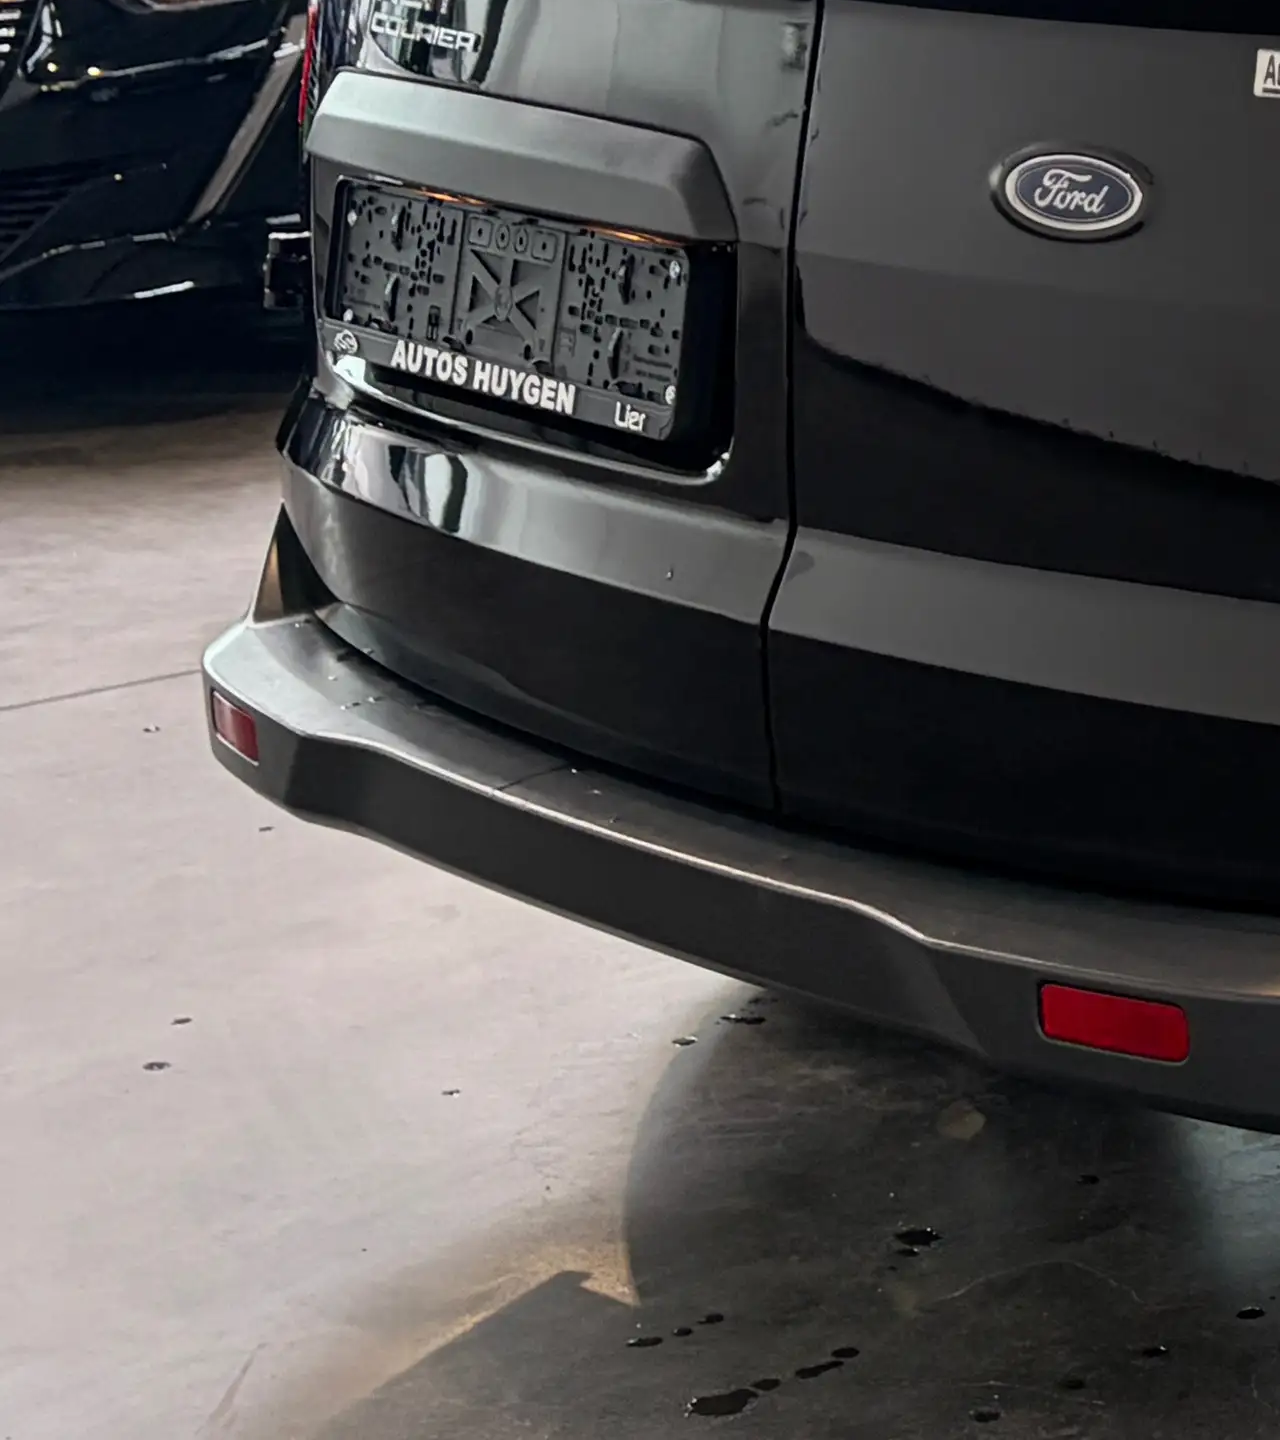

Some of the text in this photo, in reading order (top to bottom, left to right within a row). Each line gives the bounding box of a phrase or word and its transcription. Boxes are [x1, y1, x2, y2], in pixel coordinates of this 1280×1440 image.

[370, 11, 477, 53] COURIER
[1034, 168, 1109, 213] Ford
[390, 339, 647, 433] AUTOS HUYGEN Lier
